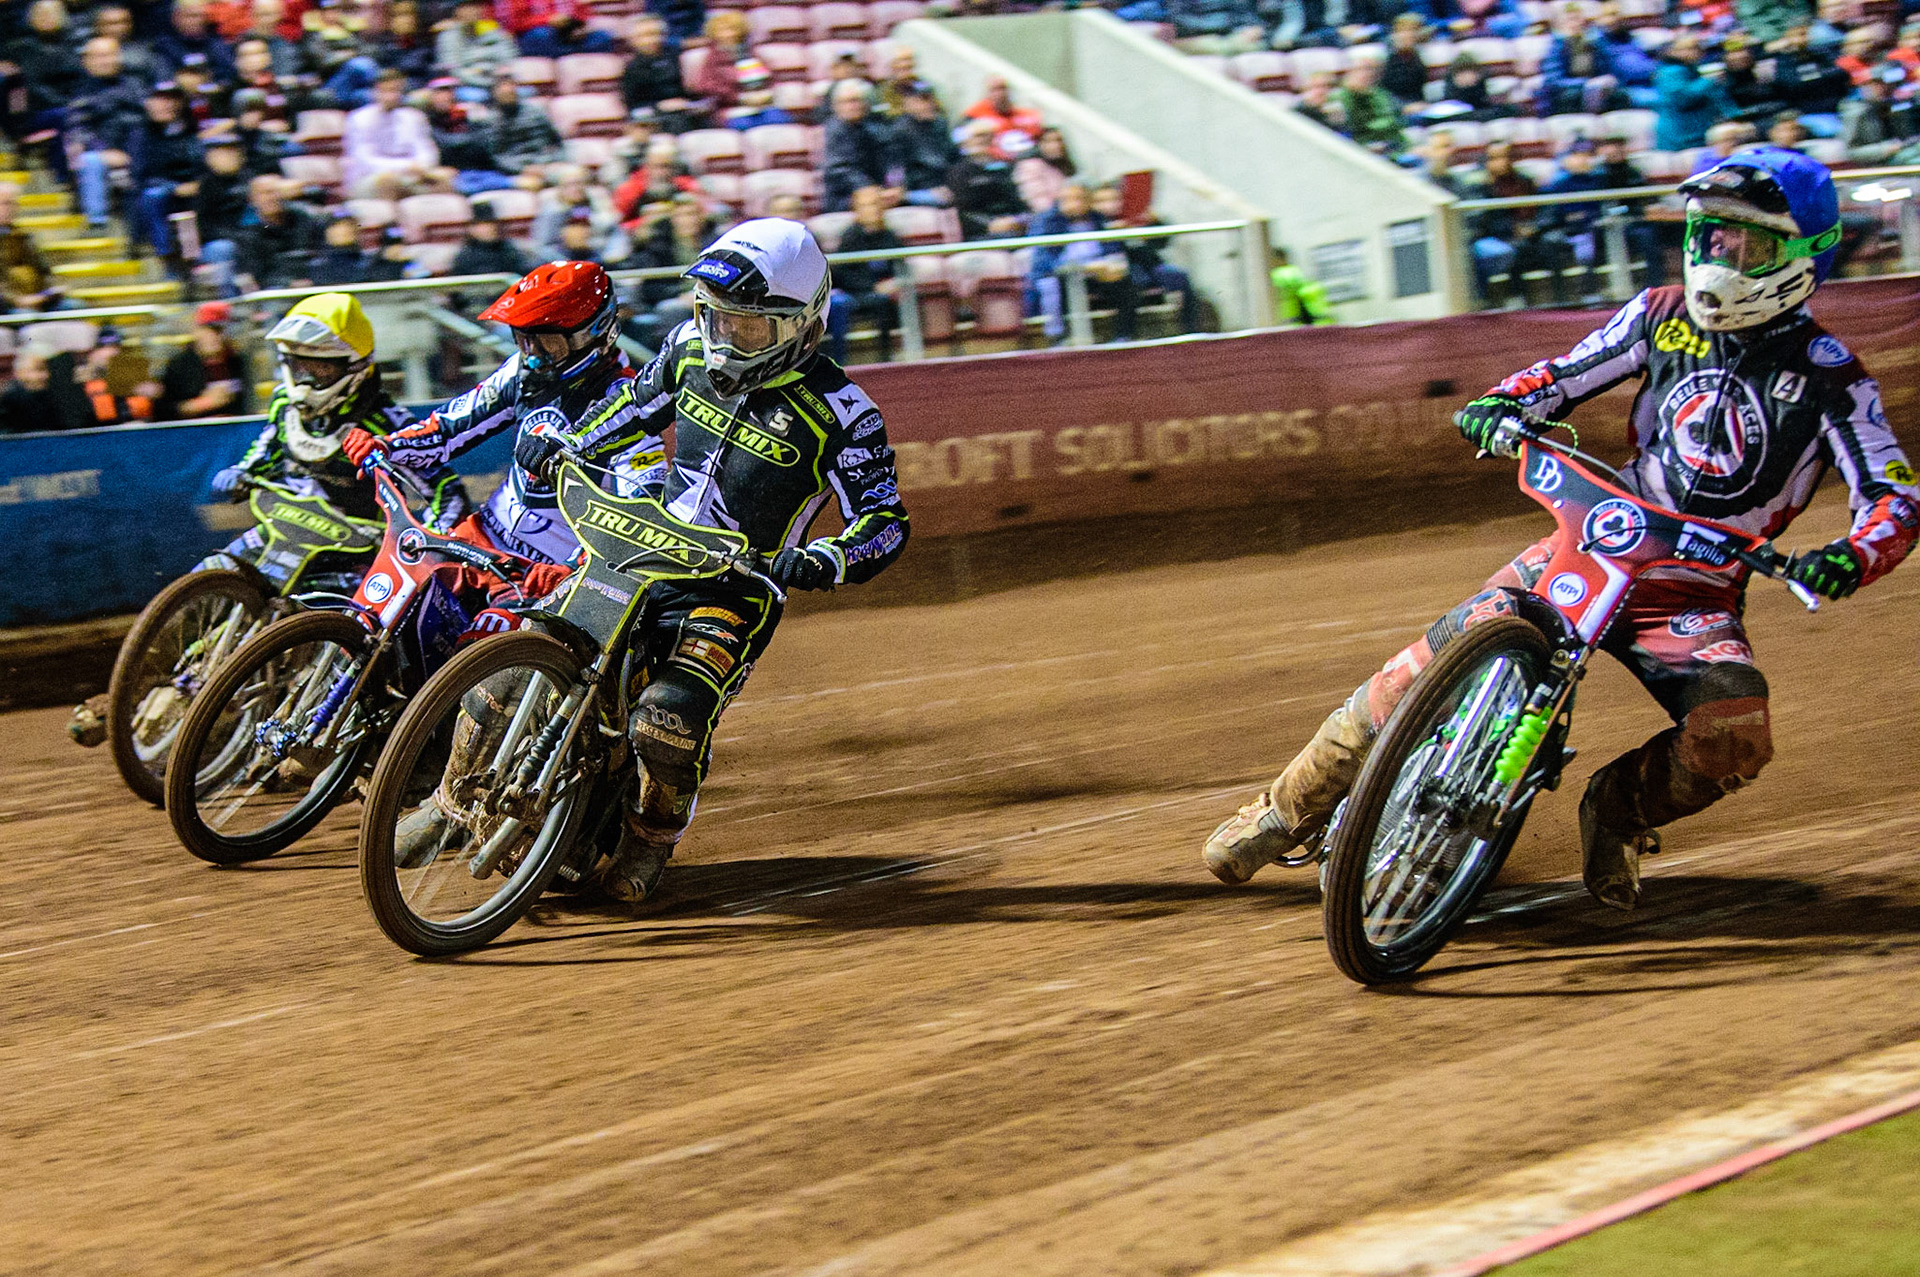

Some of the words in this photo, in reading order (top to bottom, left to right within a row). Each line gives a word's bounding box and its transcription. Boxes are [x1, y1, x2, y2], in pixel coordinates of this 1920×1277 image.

[1669, 377, 1708, 410] BELLE
[524, 412, 549, 433] BELLE
[369, 581, 388, 596] ATPI
[1556, 582, 1579, 597] ATPI
